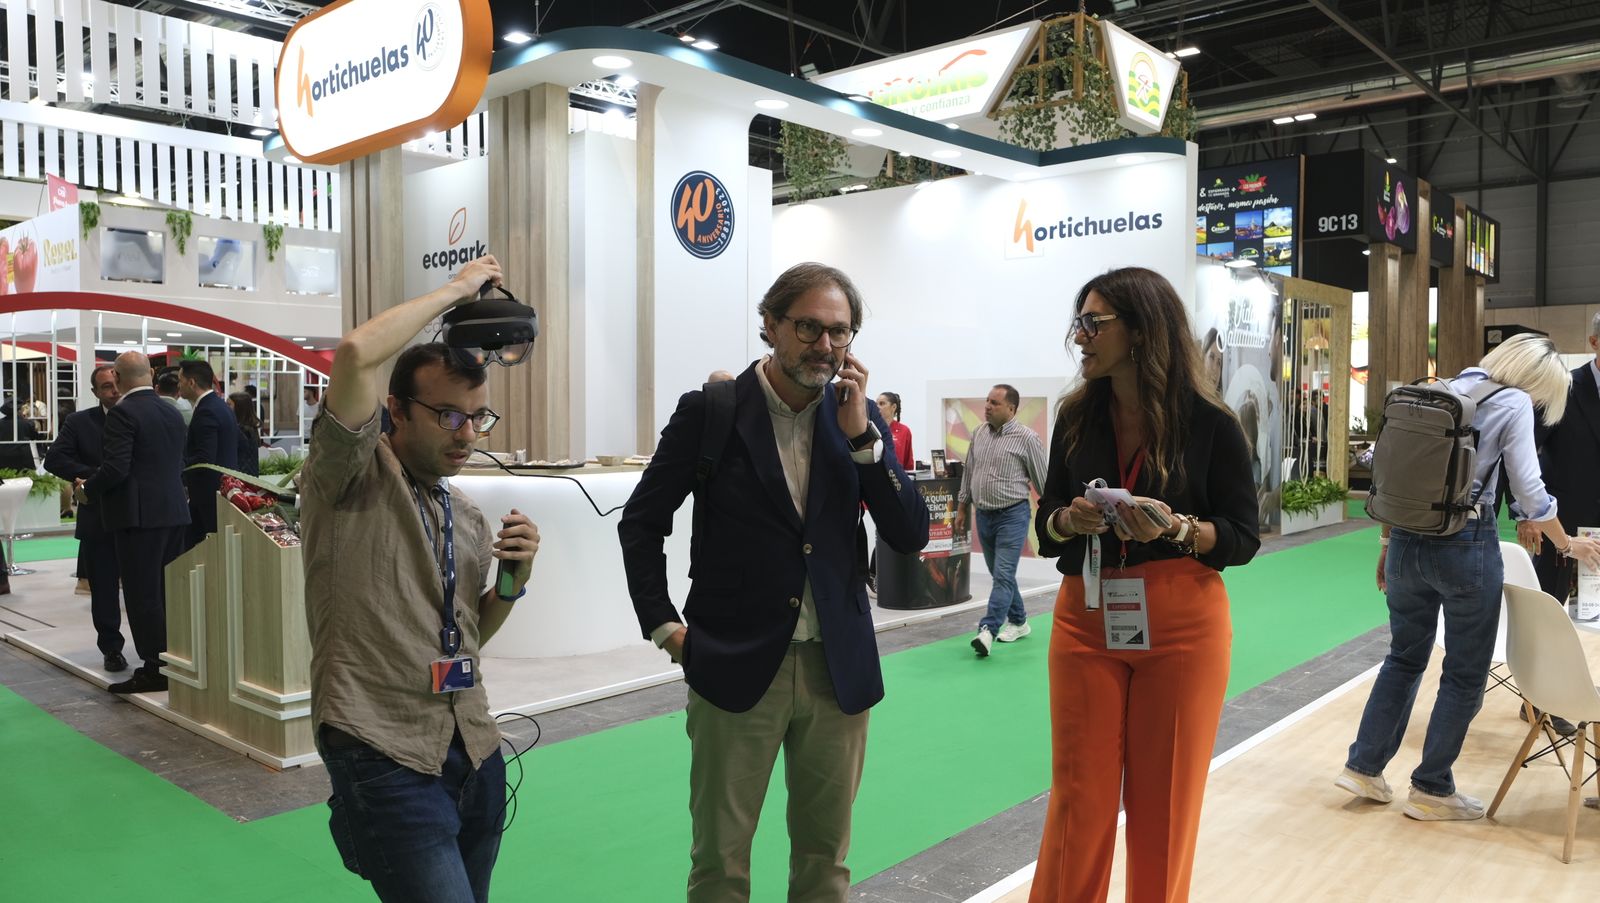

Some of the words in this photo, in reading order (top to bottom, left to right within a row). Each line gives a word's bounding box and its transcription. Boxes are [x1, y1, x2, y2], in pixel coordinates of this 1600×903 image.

[297, 44, 409, 118] hortichuelas
[920, 94, 971, 116] confianza
[677, 178, 715, 244] 40
[696, 203, 725, 244] ANIVERSARIO
[1013, 198, 1163, 253] hortichuelas
[1318, 213, 1358, 233] 9C13
[422, 240, 487, 271] ecopark
[931, 494, 953, 503] QUINTA
